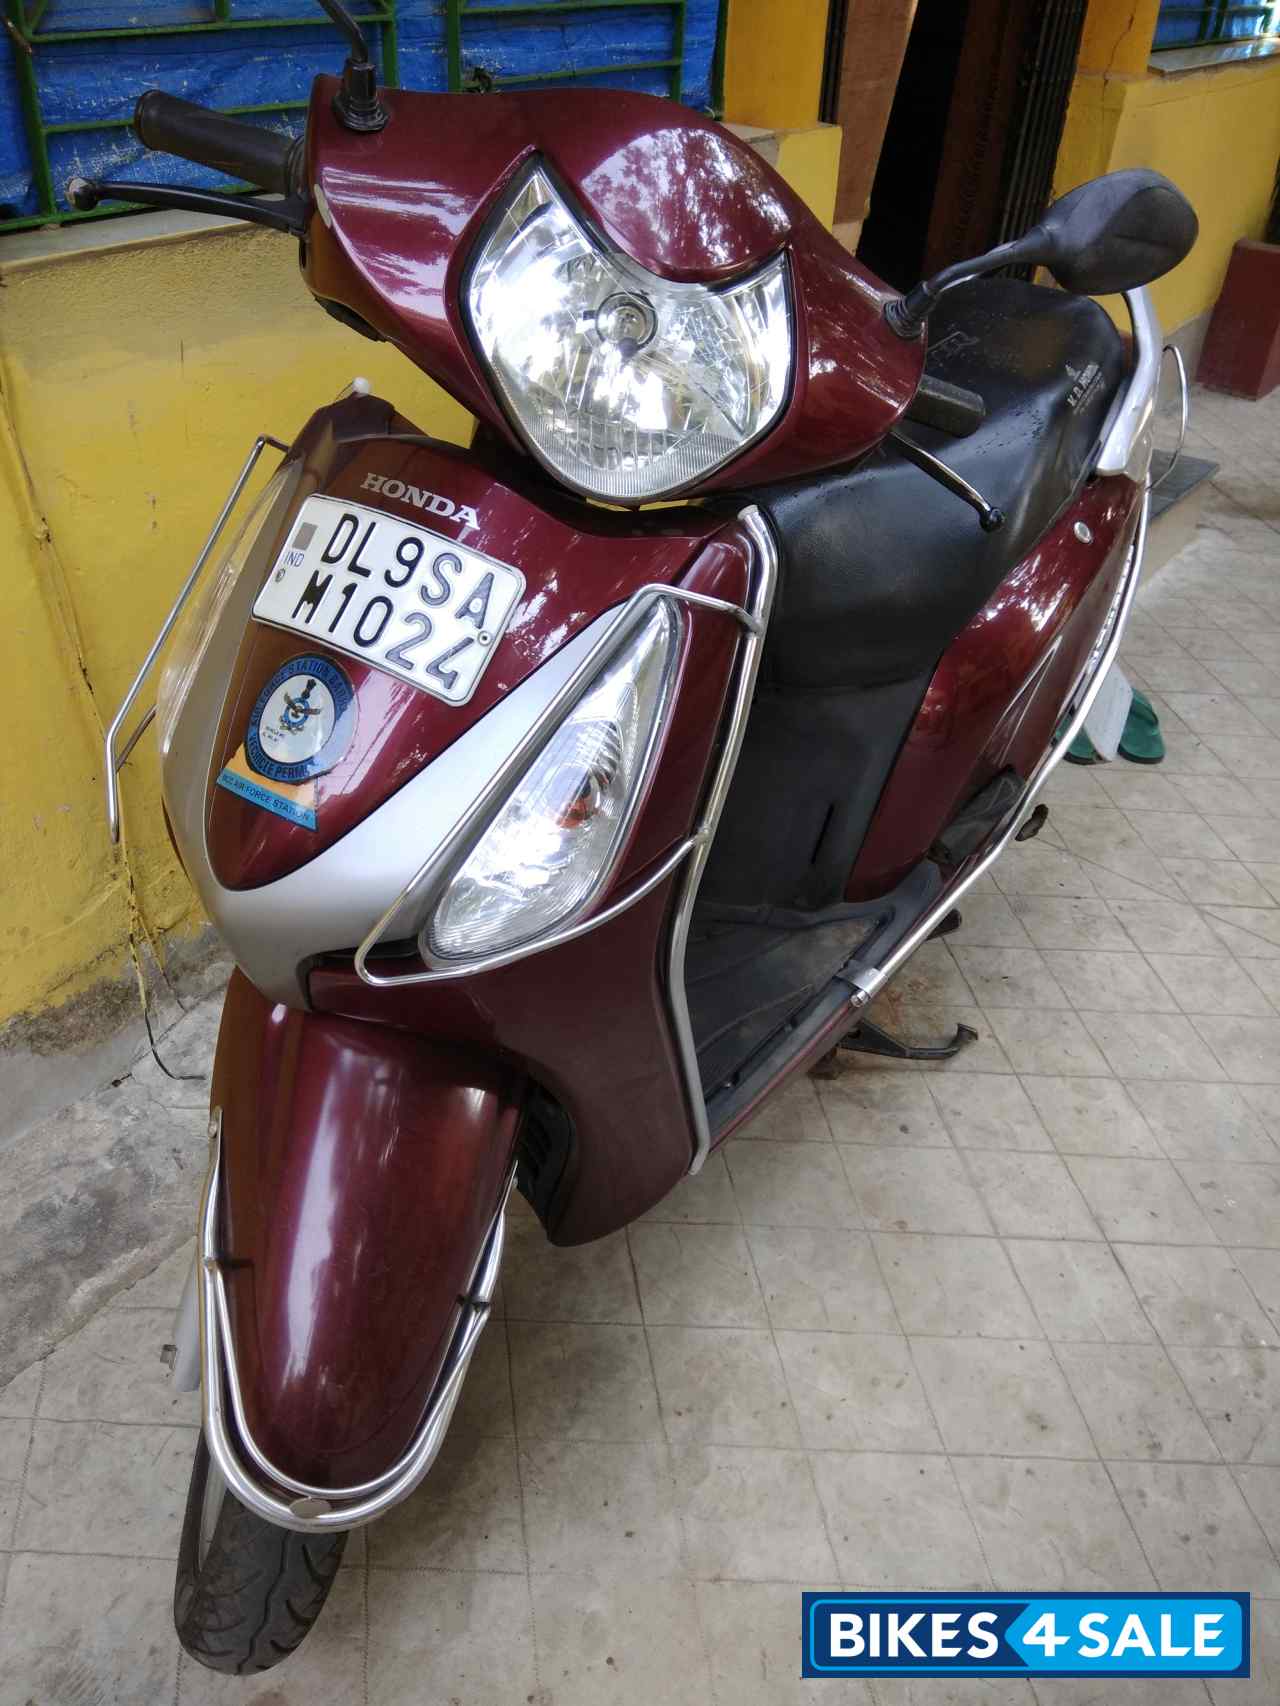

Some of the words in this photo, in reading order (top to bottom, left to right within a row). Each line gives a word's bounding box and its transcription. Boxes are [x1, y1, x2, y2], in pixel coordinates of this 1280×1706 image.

[360, 473, 481, 530] HONDA
[320, 513, 495, 630] DL9SA
[246, 786, 271, 803] FORCE
